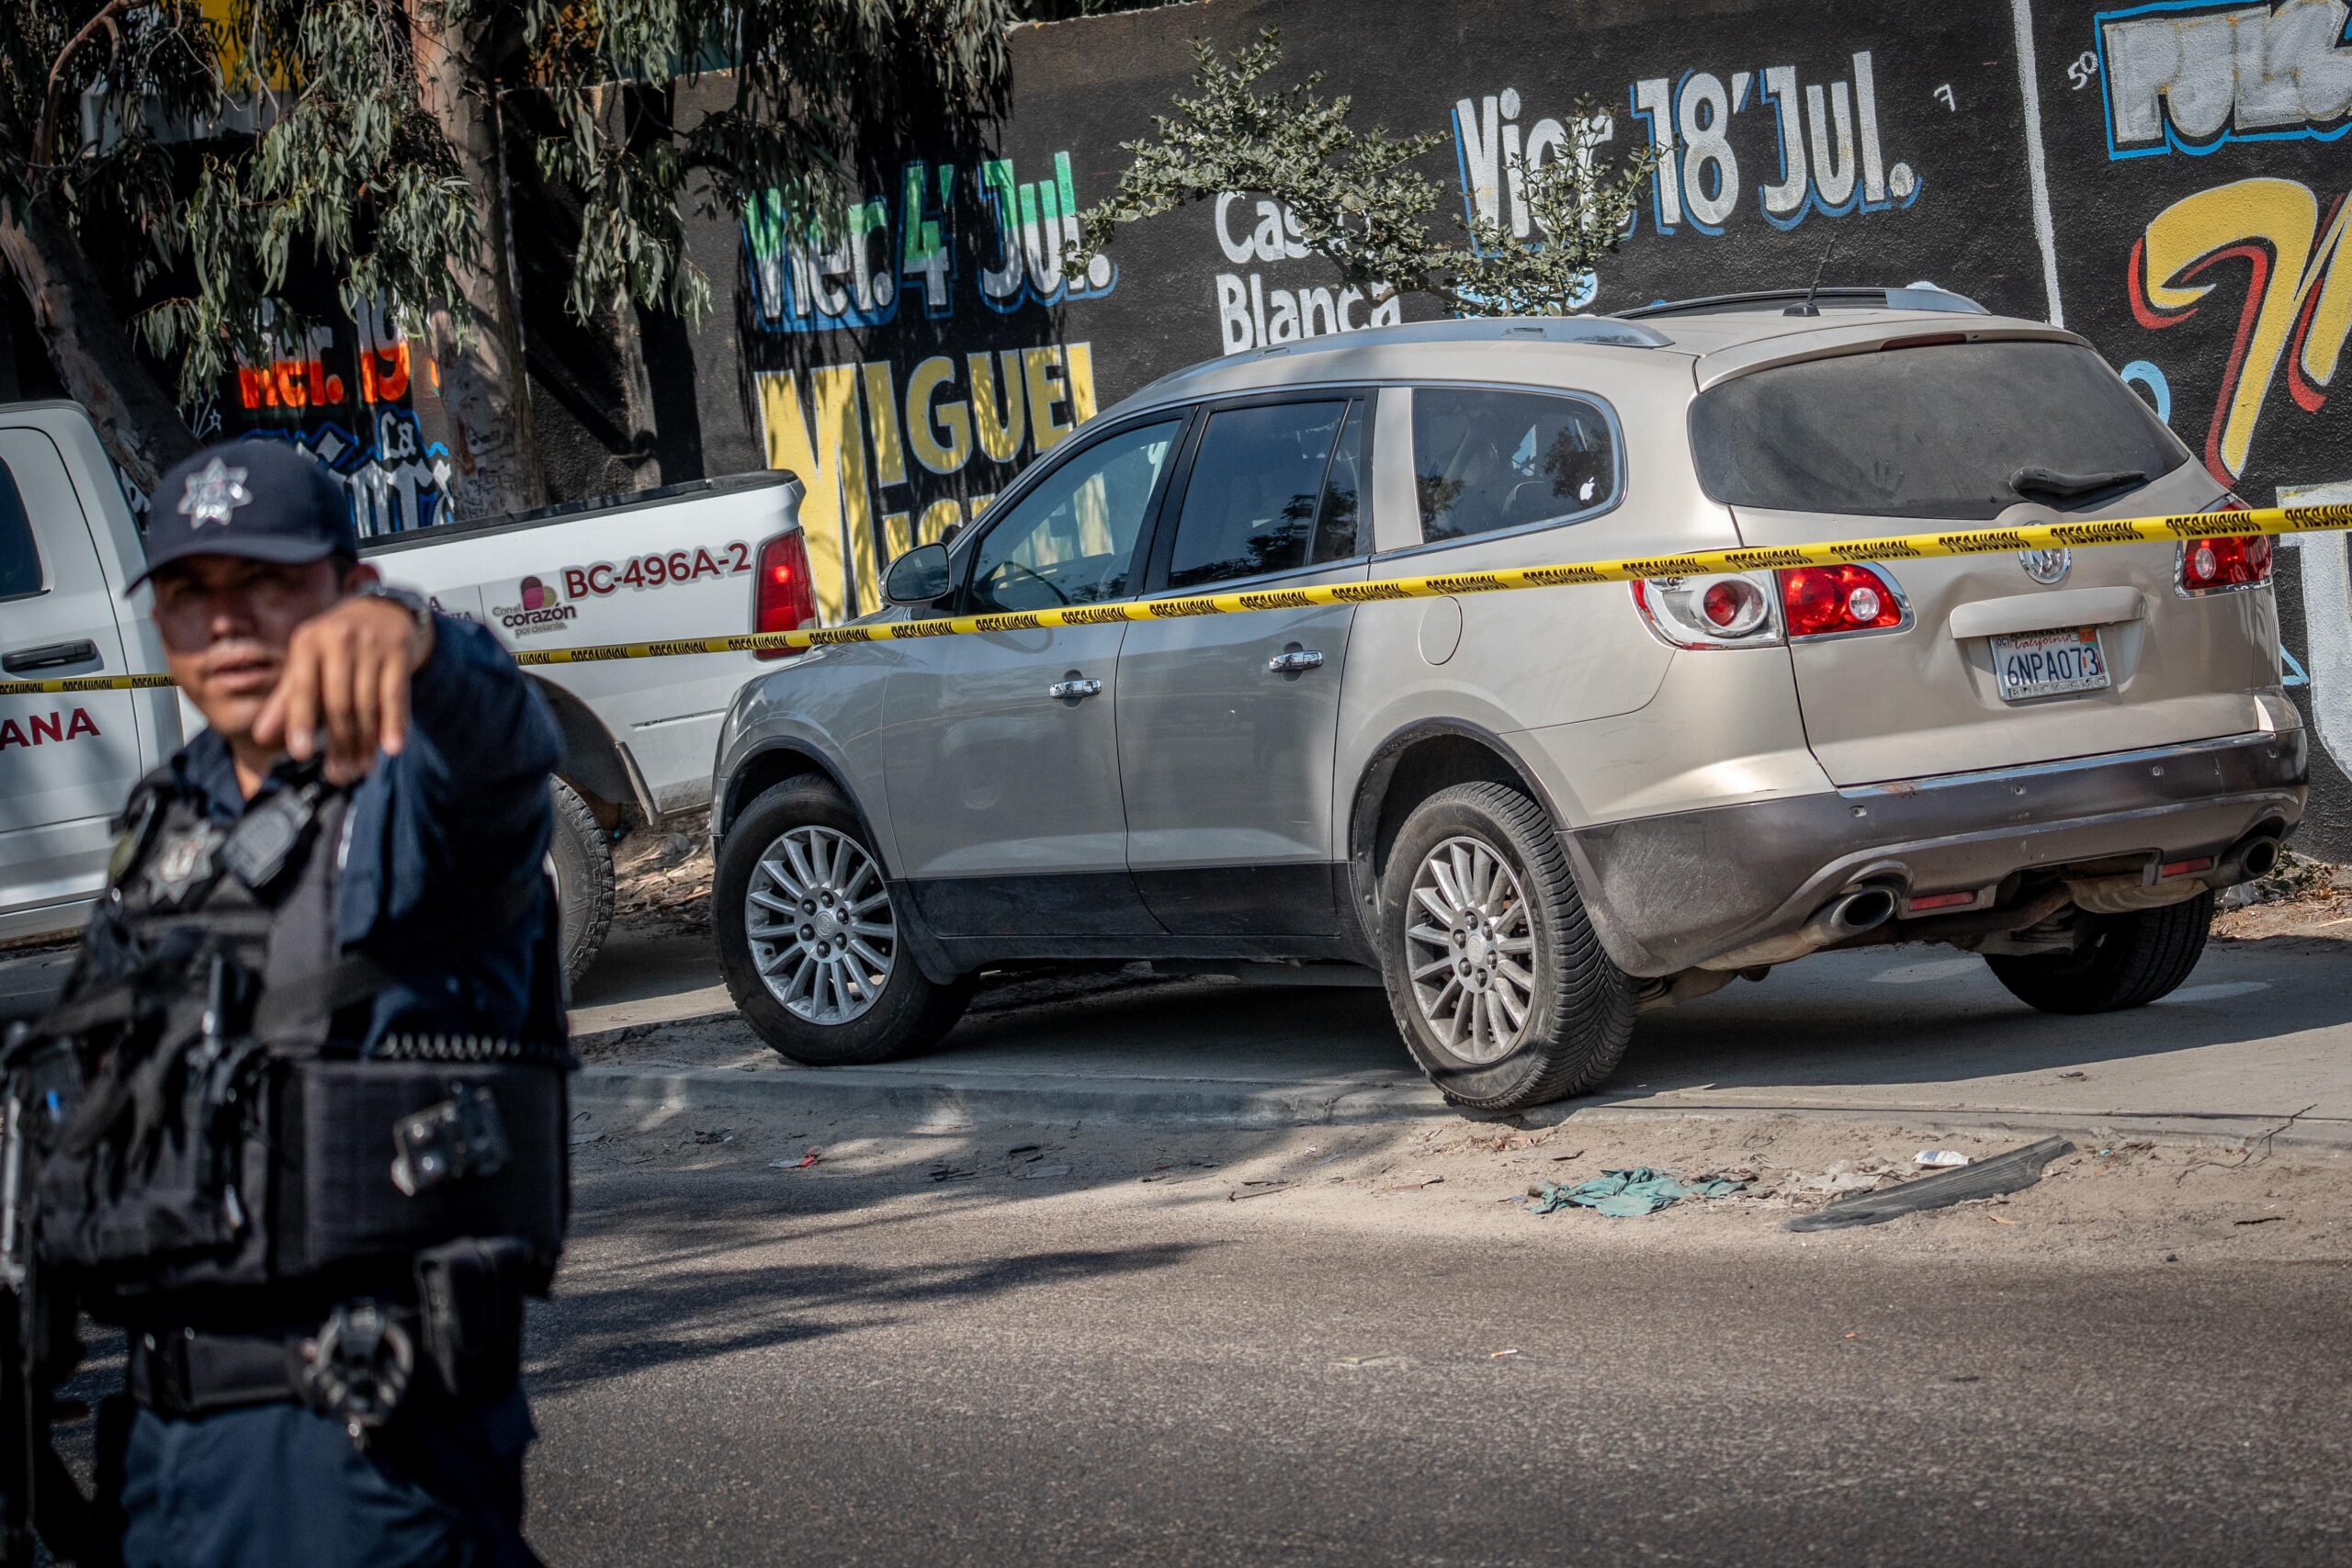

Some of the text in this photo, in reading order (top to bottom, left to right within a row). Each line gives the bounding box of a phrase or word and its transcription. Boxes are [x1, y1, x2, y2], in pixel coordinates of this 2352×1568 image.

[2067, 51, 2098, 90] 50
[1764, 51, 1915, 213] Jul.
[982, 151, 1111, 299] Jul.
[1216, 273, 1402, 356] Blanca
[565, 542, 752, 599] BC-496A-2
[492, 605, 514, 617] Con
[503, 602, 578, 627] corazón
[515, 625, 531, 639] por
[2014, 632, 2079, 650] California
[2007, 647, 2100, 686] 6NPA073
